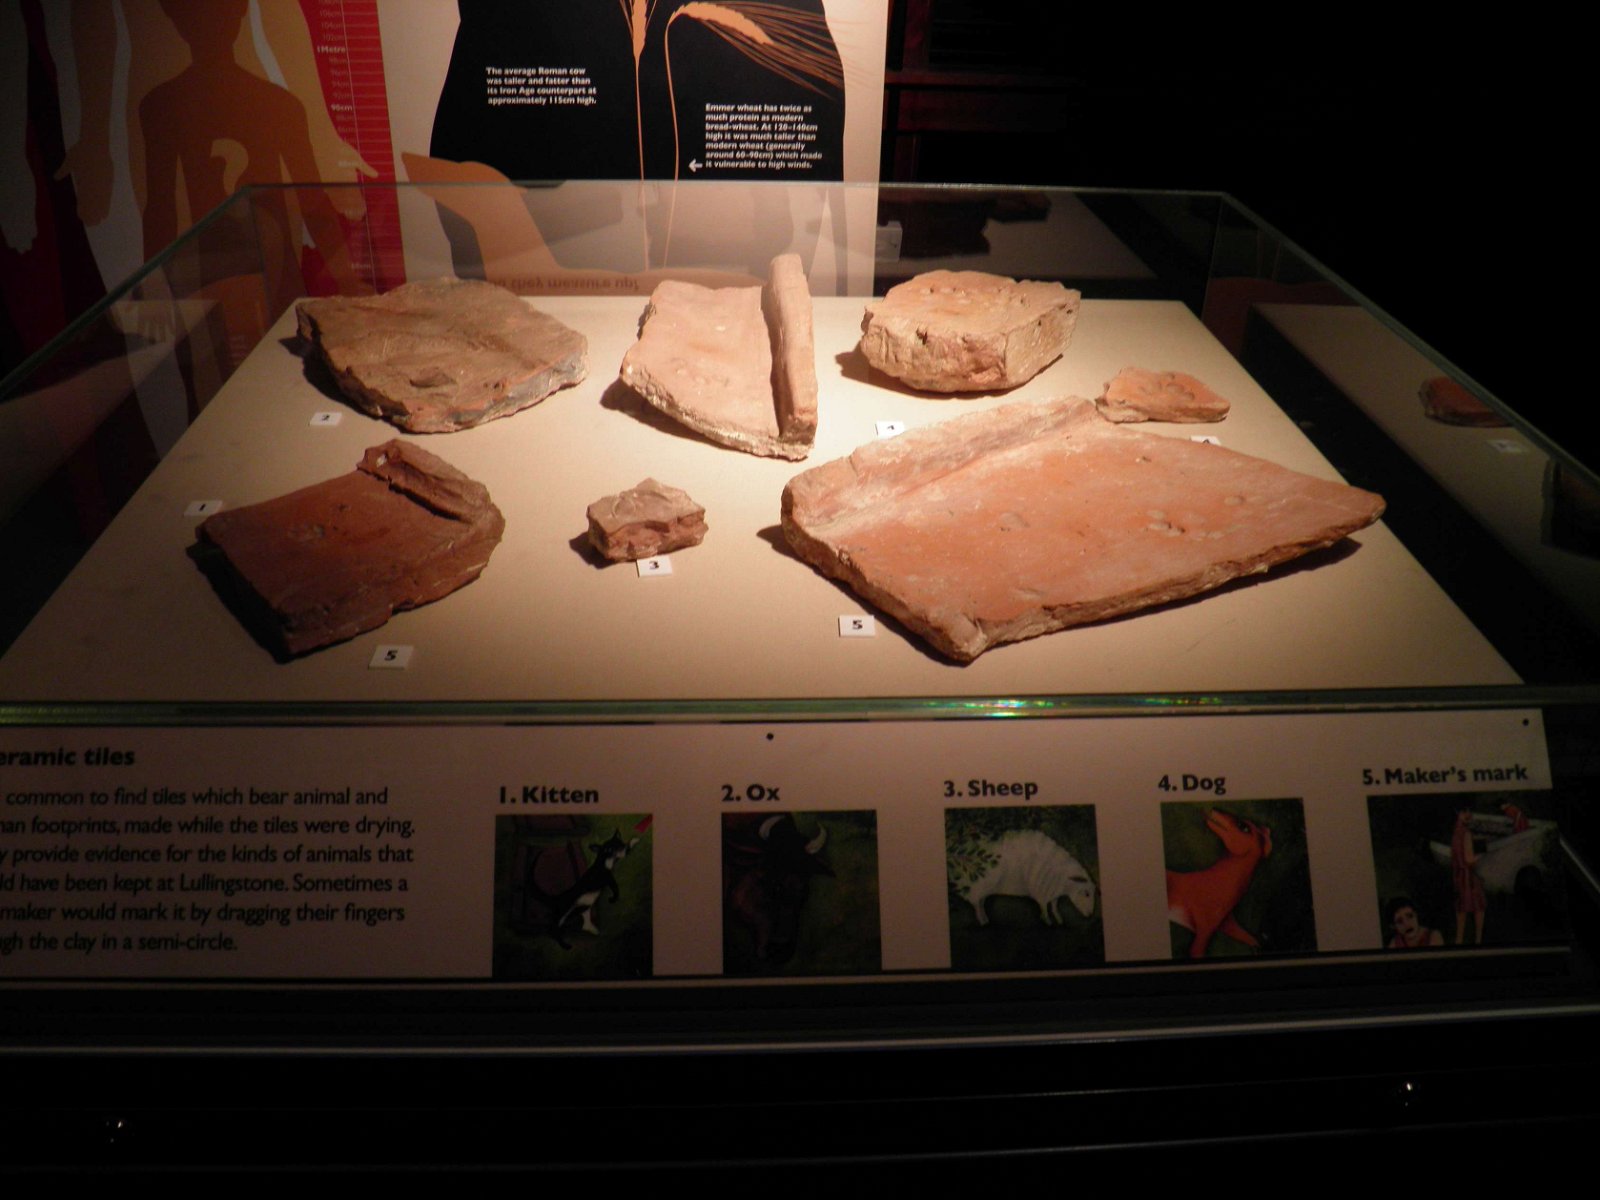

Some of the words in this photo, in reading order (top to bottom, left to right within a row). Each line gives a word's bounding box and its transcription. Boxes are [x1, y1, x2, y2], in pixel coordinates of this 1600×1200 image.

[486, 66, 503, 75] The
[504, 68, 537, 76] average
[538, 66, 567, 75] Roman
[504, 77, 526, 85] taller
[528, 77, 543, 85] and
[545, 77, 569, 85] fatter
[571, 77, 591, 85] than
[519, 87, 535, 96] Age
[537, 87, 586, 96] counterpart
[588, 87, 597, 95] at
[488, 96, 547, 106] approximately
[577, 96, 597, 106] high.
[705, 103, 735, 112] Emmer
[737, 103, 762, 112] wheat
[764, 104, 778, 112] has
[780, 104, 802, 113] twice
[705, 113, 728, 121] much
[729, 114, 760, 122] protein
[772, 114, 804, 122] modern
[761, 123, 771, 131] At
[705, 132, 723, 141] high
[724, 132, 731, 140] it
[750, 132, 773, 140] much
[774, 132, 796, 141] taller
[797, 133, 816, 141] than
[705, 141, 737, 149] modern
[739, 142, 764, 150] wheat
[765, 142, 806, 152] (generally
[705, 151, 734, 159] around
[775, 151, 799, 159] which
[705, 160, 713, 168] it
[714, 160, 756, 168] vulnerable
[757, 160, 767, 168] to
[768, 160, 786, 170] high
[787, 161, 813, 169] winds.
[649, 560, 660, 570] 3
[852, 619, 863, 630] 5
[384, 649, 398, 661] 5
[84, 747, 135, 766] tiles
[1362, 768, 1380, 785] 5.
[1384, 766, 1467, 785] Maker's
[1473, 764, 1528, 781] mark
[943, 780, 962, 797] 3.
[968, 779, 1038, 800] Sheep
[1158, 774, 1177, 791] 4.
[1182, 774, 1226, 795] Dog
[5, 792, 84, 806] common
[90, 790, 109, 806] to
[114, 786, 147, 805] find
[152, 787, 186, 806] tiles
[192, 787, 243, 805] which
[249, 787, 289, 805] bear
[293, 787, 350, 805] animal
[355, 787, 388, 805] and
[522, 786, 599, 803] Kitten
[721, 784, 741, 801] 2.
[746, 784, 780, 801] Ox
[31, 816, 120, 839] footprints,
[124, 816, 173, 834] made
[177, 816, 224, 833] while
[229, 816, 258, 834] the
[264, 816, 298, 834] tiles
[304, 821, 349, 833] were
[355, 816, 415, 839] drying.
[12, 845, 79, 868] provide
[84, 844, 161, 863] evidence
[166, 844, 192, 863] for
[198, 845, 226, 863] the
[232, 844, 277, 863] kinds
[283, 844, 303, 863] of
[306, 845, 372, 863] animals
[378, 844, 413, 863] that
[20, 873, 59, 891] have
[64, 873, 107, 892] been
[113, 873, 153, 897] kept
[157, 876, 174, 891] at
[179, 873, 289, 897] Lullingstone.
[292, 873, 392, 892] Sometimes
[398, 879, 408, 891] a
[0, 902, 56, 921] maker
[61, 902, 117, 921] would
[121, 902, 168, 921] mark
[173, 904, 186, 921] it
[190, 902, 212, 926] by
[216, 902, 291, 927] dragging
[296, 902, 339, 922] their
[344, 902, 405, 927] fingers
[29, 932, 58, 950] the
[63, 931, 96, 955] clay
[101, 933, 118, 950] in
[123, 936, 133, 950] a
[138, 932, 237, 952] semi-circle.
